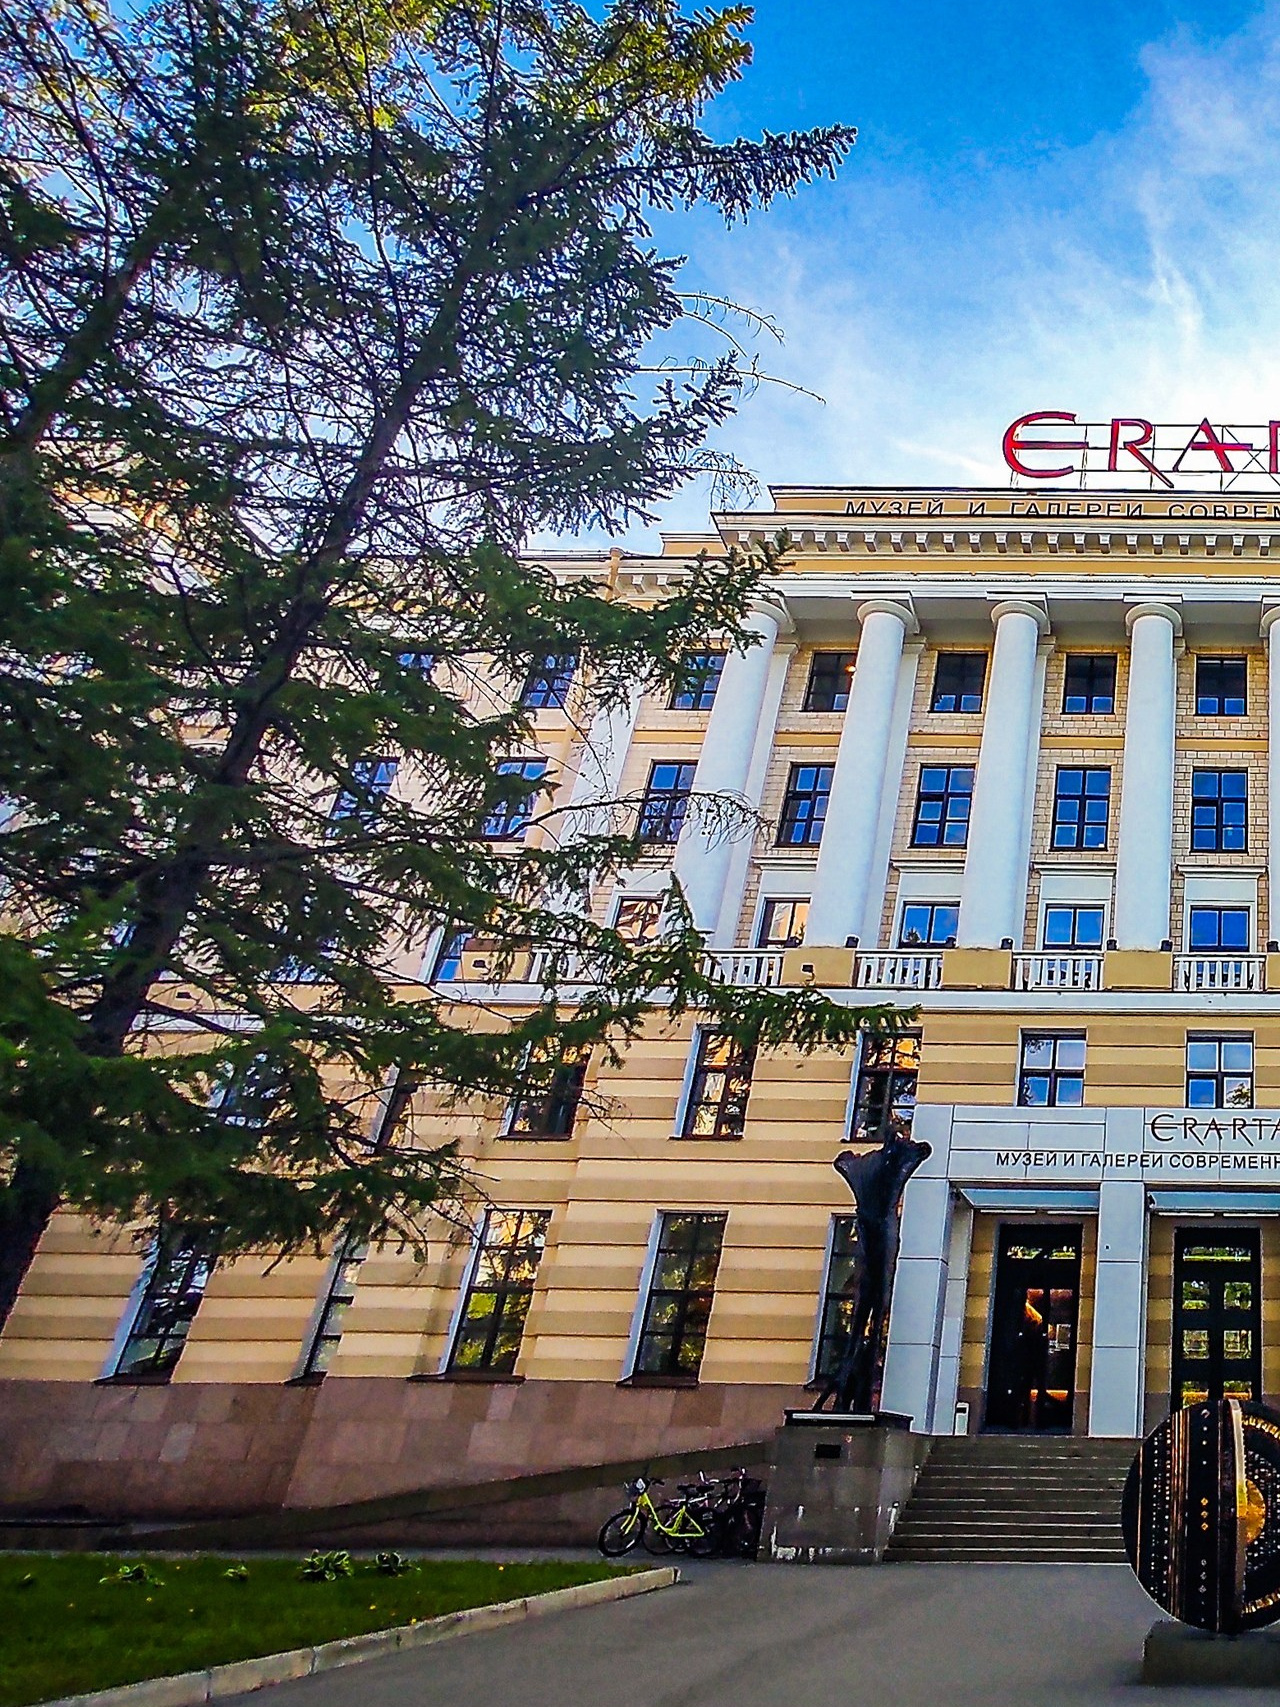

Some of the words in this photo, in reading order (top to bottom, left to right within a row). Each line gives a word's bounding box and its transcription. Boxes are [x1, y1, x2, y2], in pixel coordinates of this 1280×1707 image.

[844, 498, 944, 516] МУЗЕЙ
[968, 502, 986, 516] И
[1009, 502, 1144, 518] ГАЛЕРЕИ
[996, 1151, 1058, 1167] МУЗЕЙ
[1063, 1153, 1075, 1167] И
[1081, 1153, 1163, 1168] ГАЛЕРЕИ
